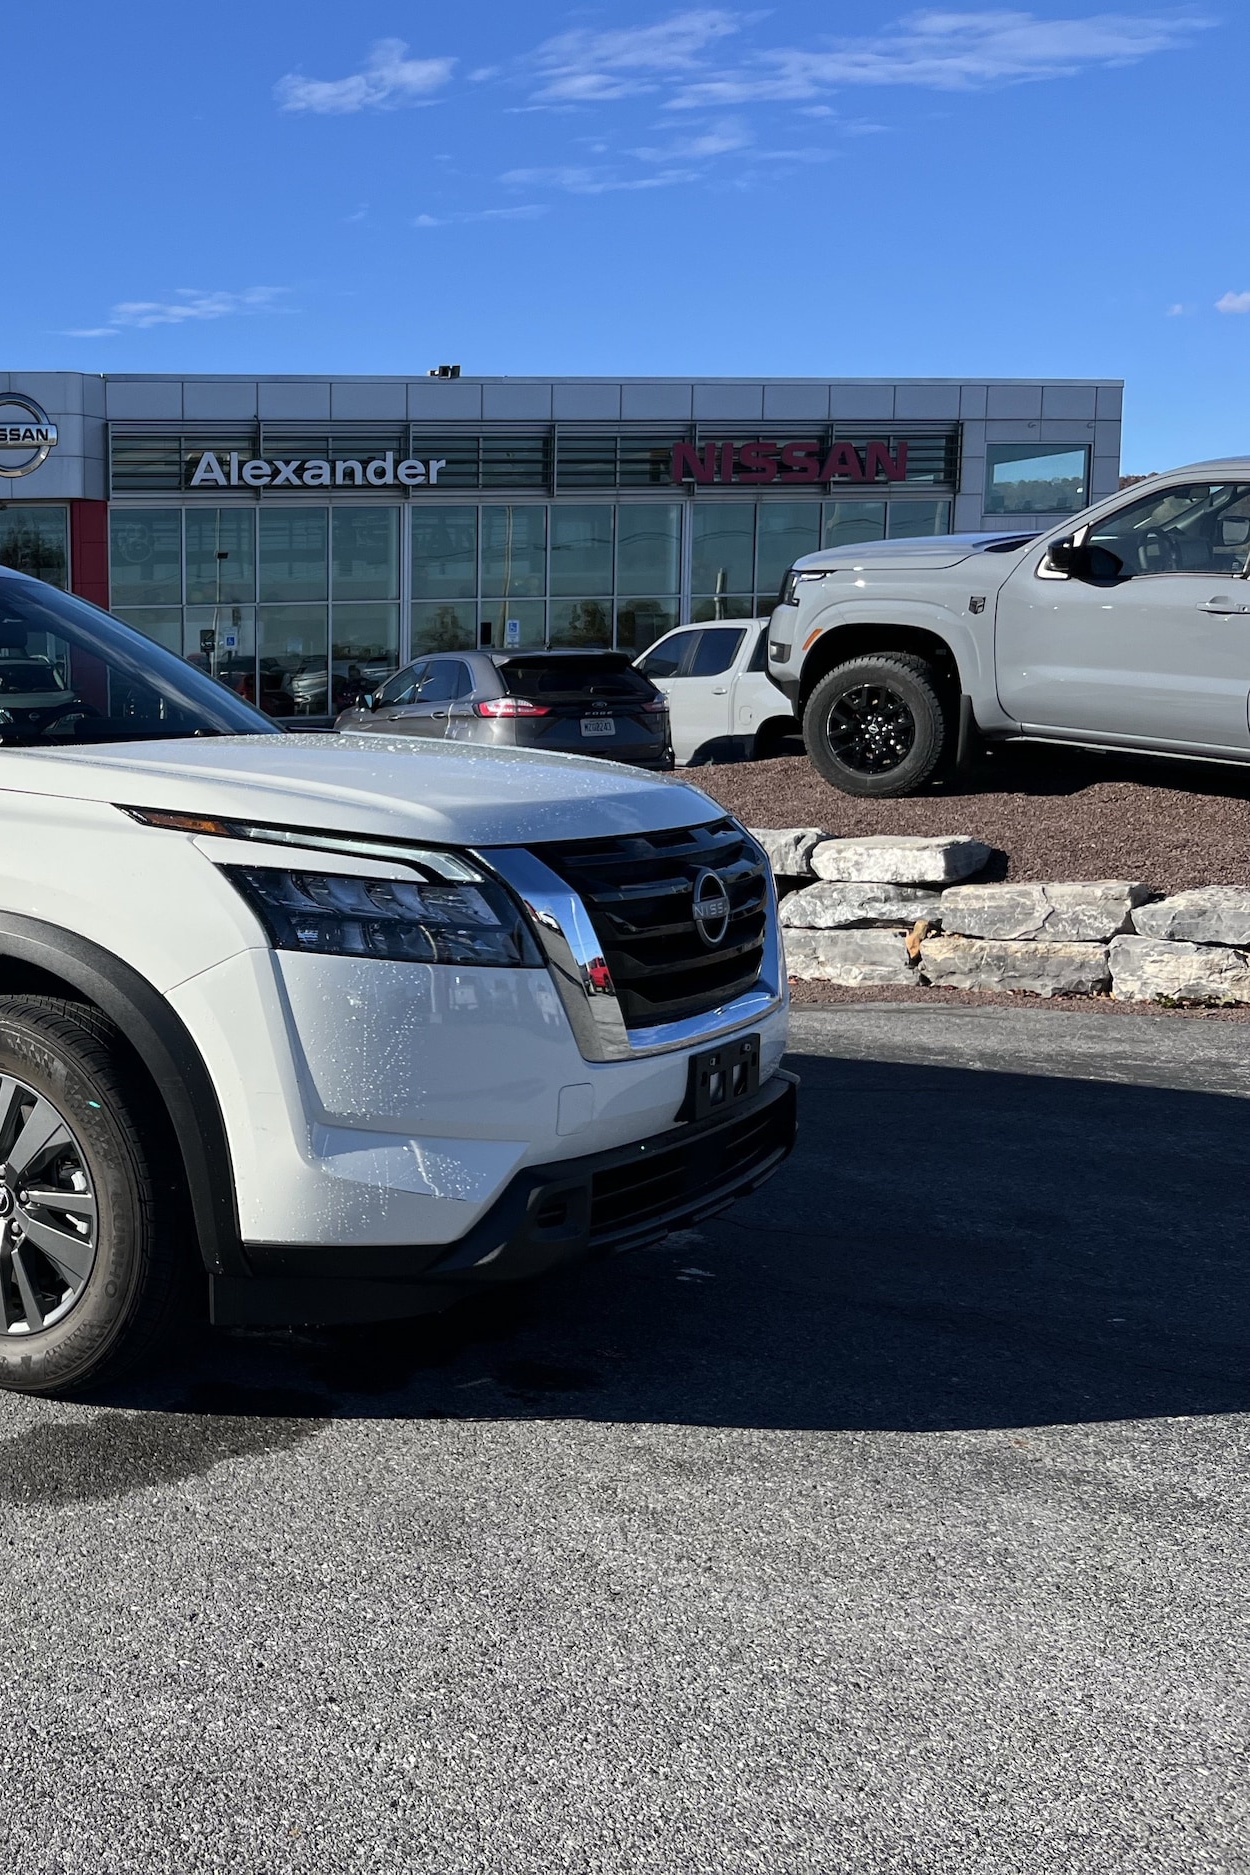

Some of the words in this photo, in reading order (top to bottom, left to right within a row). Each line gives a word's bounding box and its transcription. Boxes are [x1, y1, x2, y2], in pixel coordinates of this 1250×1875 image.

[190, 451, 447, 486] Alexander
[672, 441, 908, 483] NISSAN
[694, 902, 727, 917] NISS
